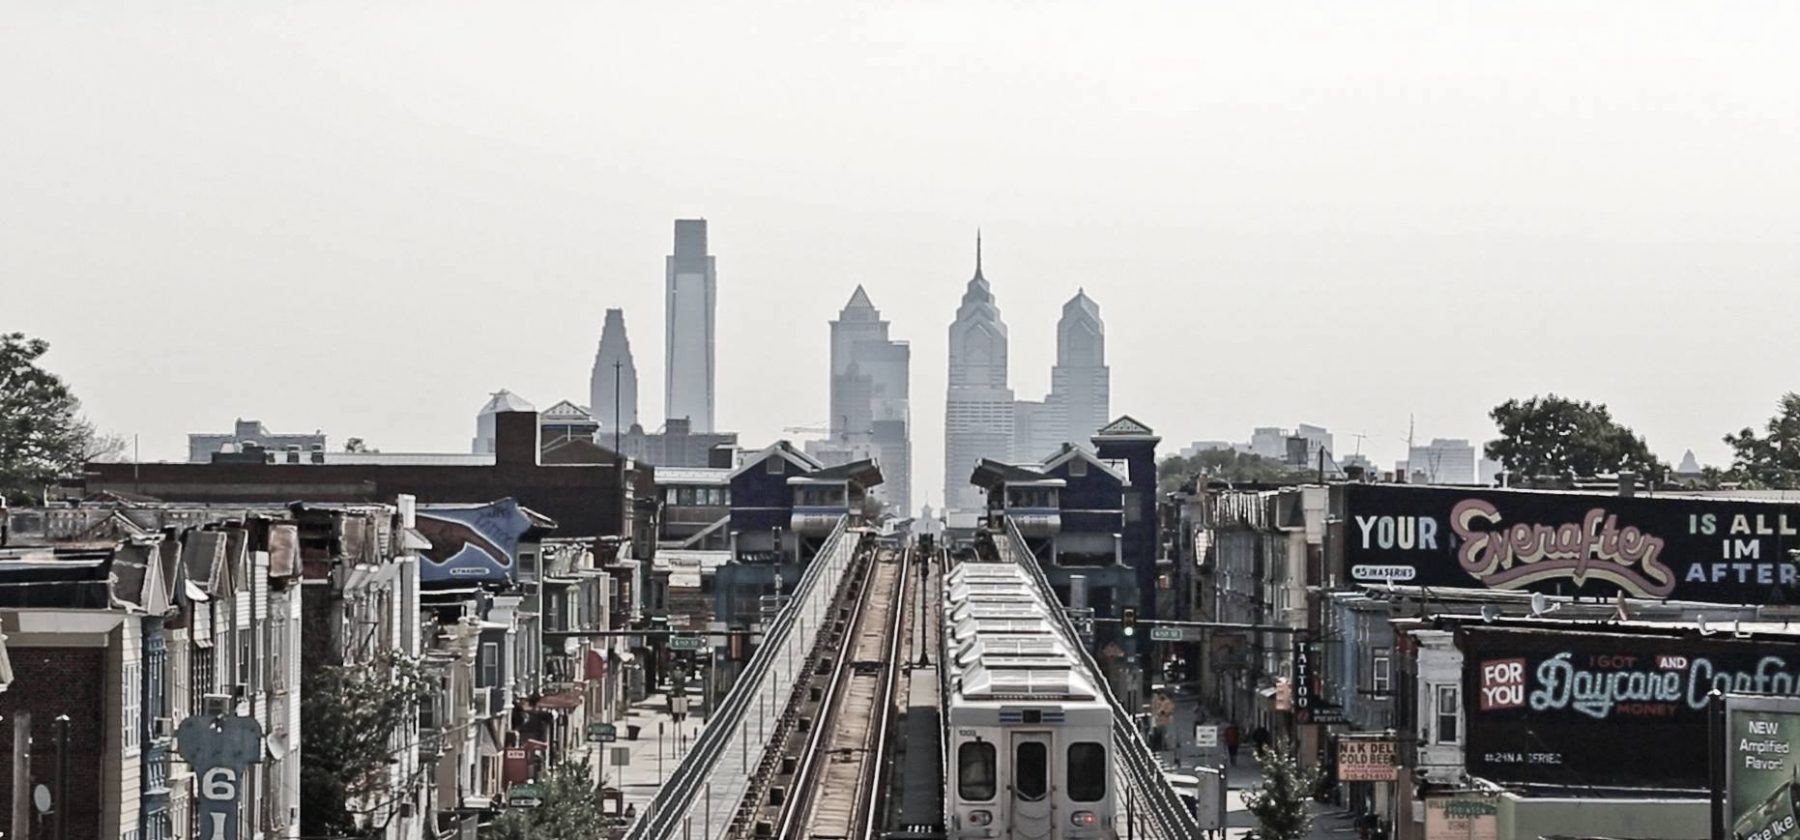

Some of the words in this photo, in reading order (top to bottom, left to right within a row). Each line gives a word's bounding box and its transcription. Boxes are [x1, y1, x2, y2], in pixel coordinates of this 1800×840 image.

[1689, 513, 1717, 535] IS
[1730, 513, 1797, 535] ALL
[1355, 515, 1437, 549] YOUR
[1450, 498, 1676, 599] Everafter
[1723, 539, 1760, 559] IM
[1684, 563, 1798, 584] AFTER
[1484, 662, 1523, 685] FOR
[1660, 657, 1688, 669] AND
[1298, 642, 1308, 708] TATTOO
[1529, 652, 1681, 718] Daycare
[1482, 684, 1524, 707] YOU
[1617, 703, 1679, 716] MONEY
[1748, 721, 1779, 735] NEW
[1740, 738, 1790, 756] Amplified
[1340, 754, 1367, 764] COLD
